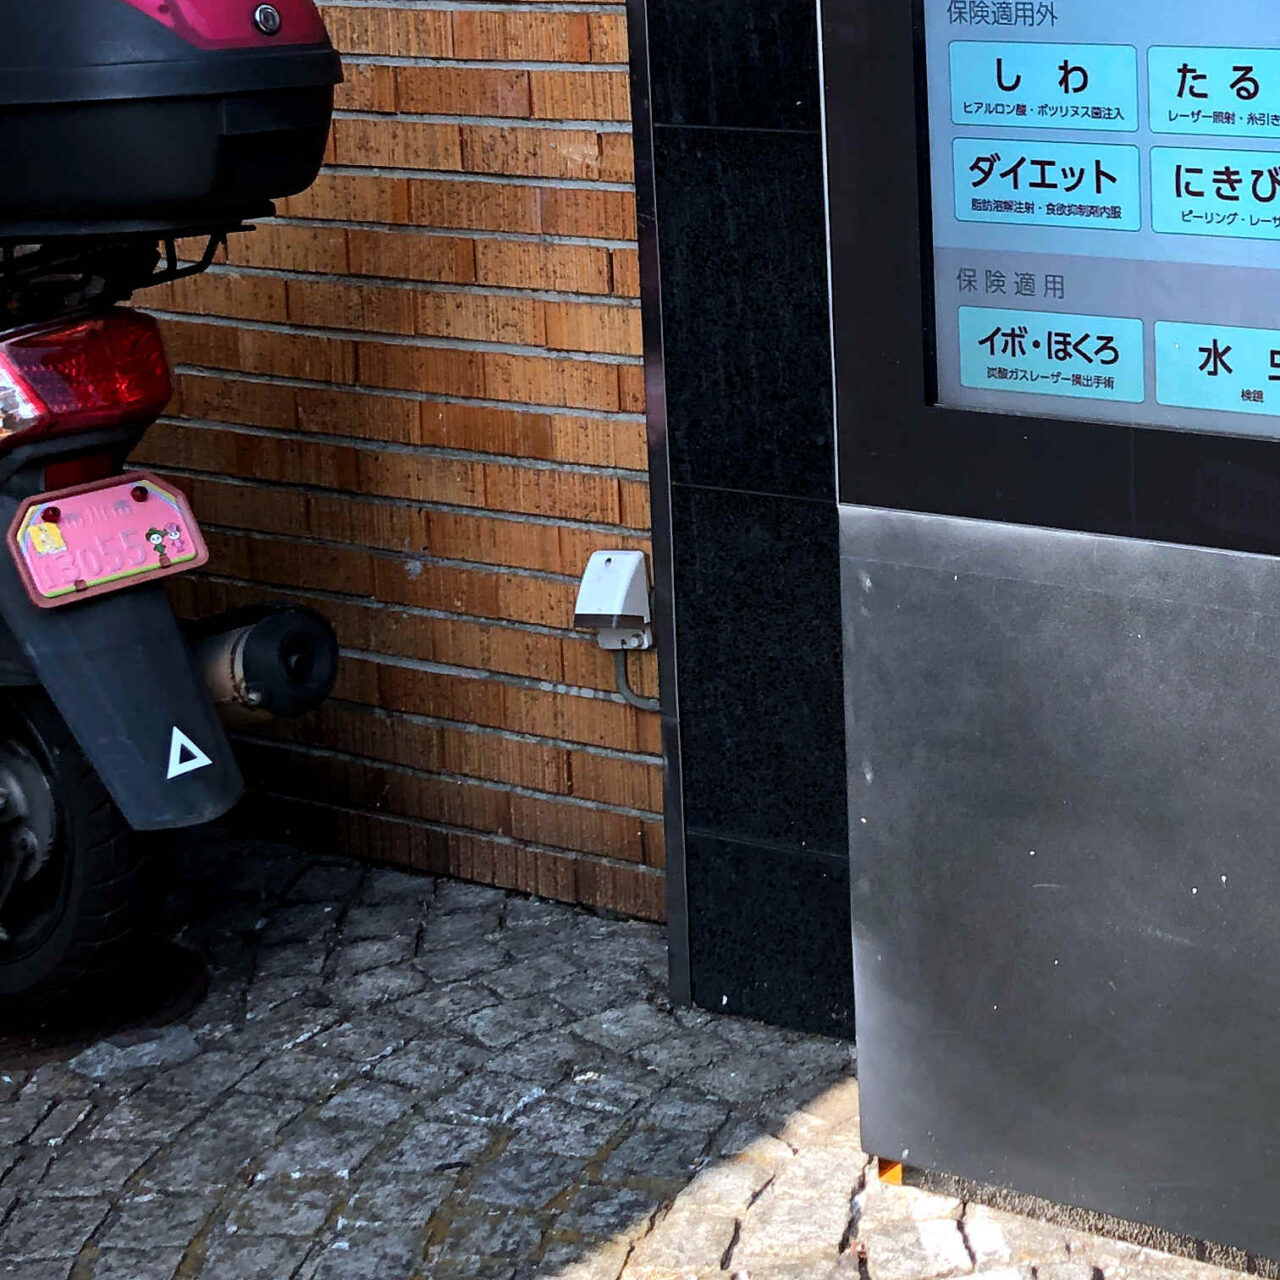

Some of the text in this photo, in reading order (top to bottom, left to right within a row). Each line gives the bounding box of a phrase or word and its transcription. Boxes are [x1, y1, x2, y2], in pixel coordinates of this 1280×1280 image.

[946, 0, 1059, 28] 保険適用外
[968, 152, 1118, 195] ダイエット
[956, 267, 1066, 300] 保険適用
[977, 325, 1121, 365] イボ・ほくろ
